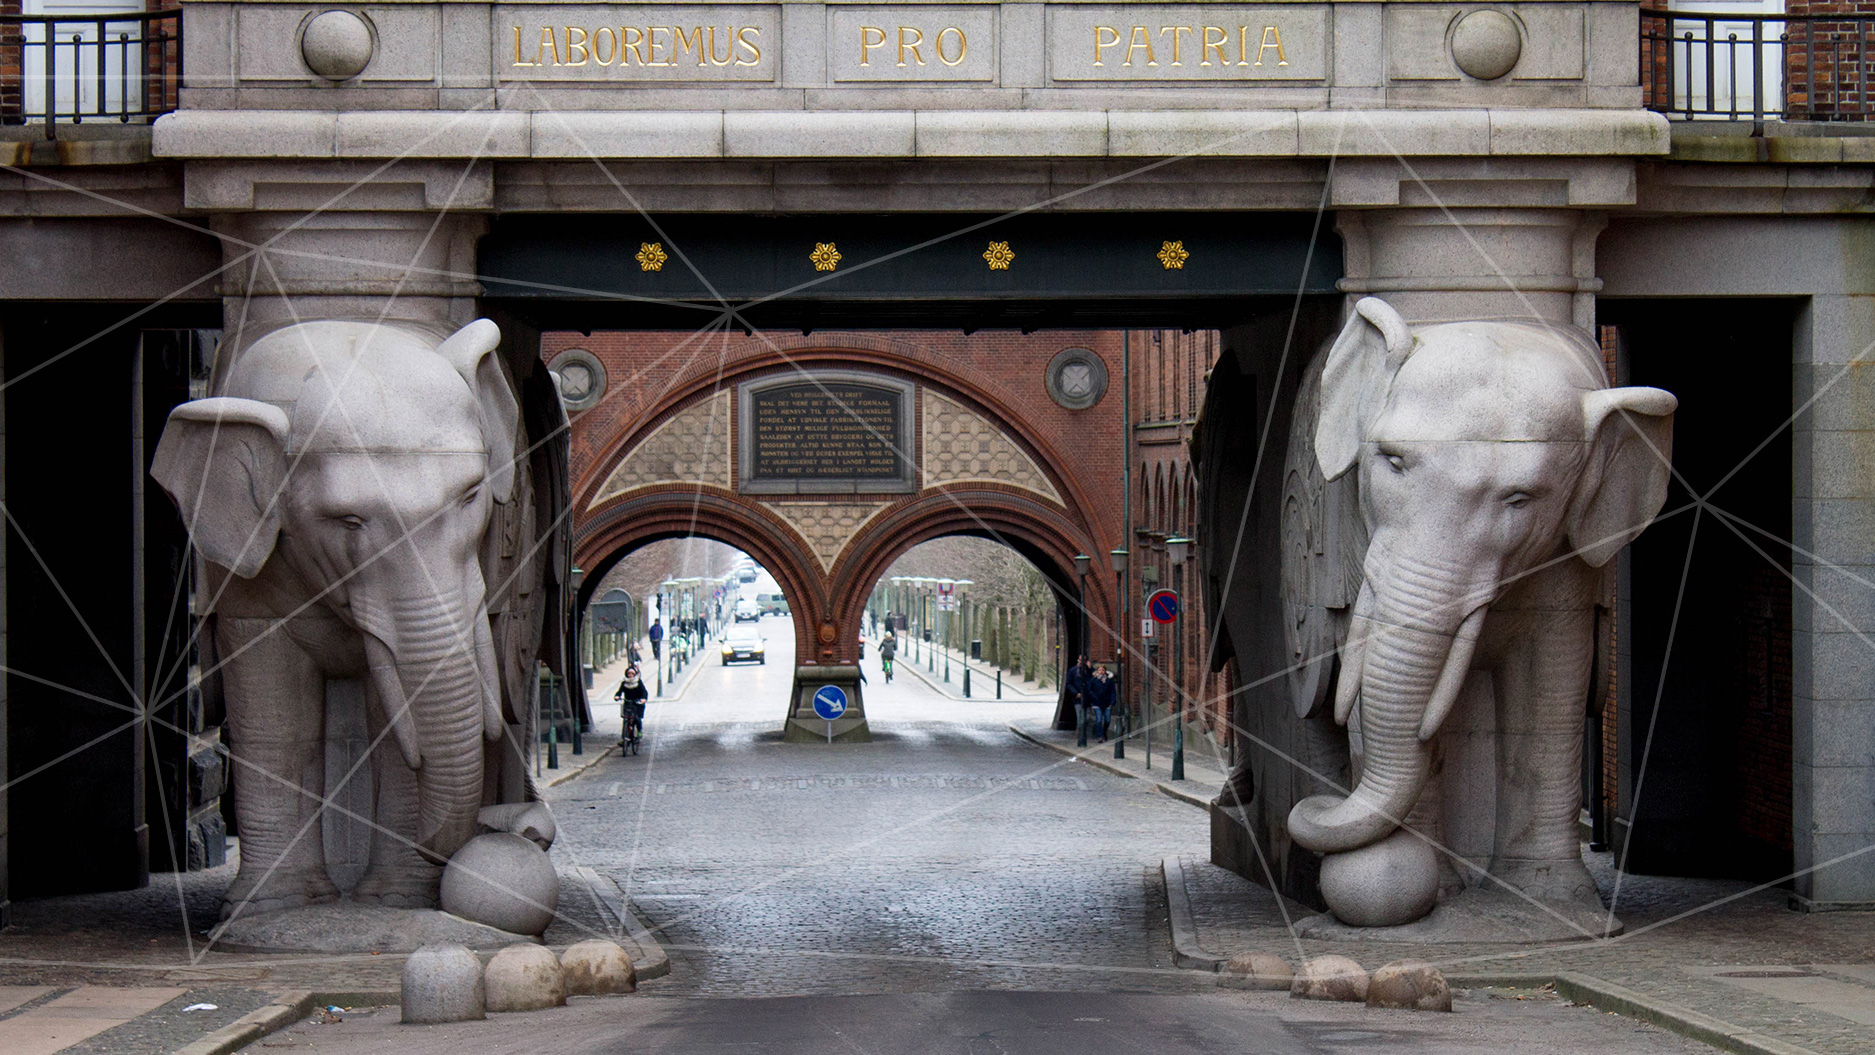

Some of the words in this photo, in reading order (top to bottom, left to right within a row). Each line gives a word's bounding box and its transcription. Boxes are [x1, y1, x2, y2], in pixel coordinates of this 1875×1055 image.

[512, 26, 762, 67] LABOREMUS
[861, 26, 968, 67] PRO
[1093, 25, 1288, 67] PATRIA
